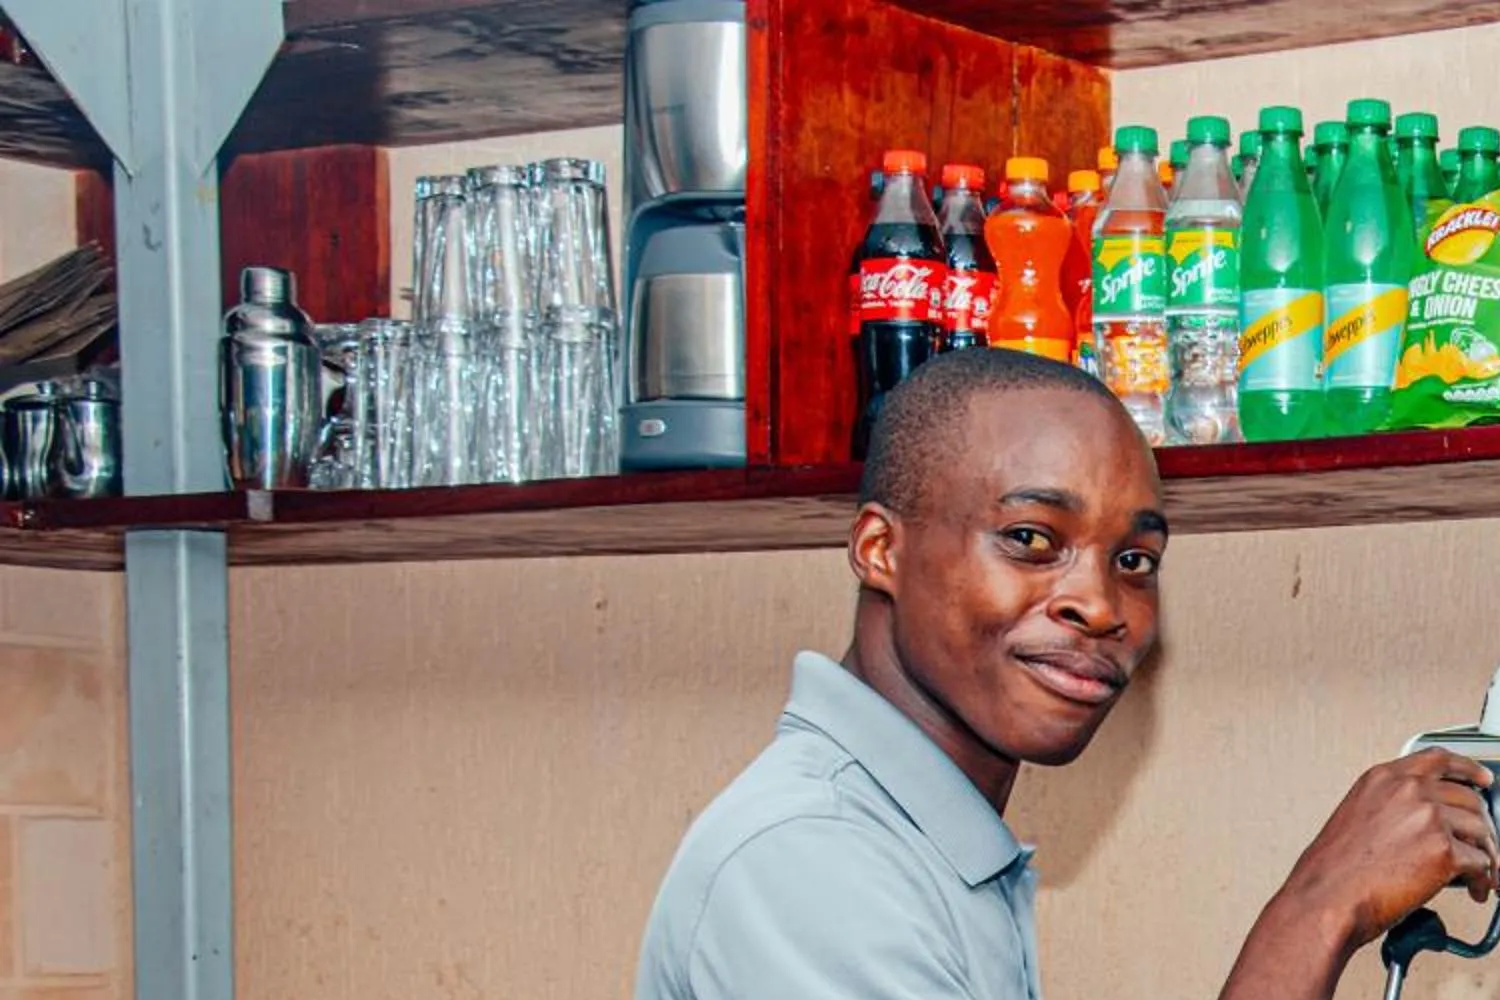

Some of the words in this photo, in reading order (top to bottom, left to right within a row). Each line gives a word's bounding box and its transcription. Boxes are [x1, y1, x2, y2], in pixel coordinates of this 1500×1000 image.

[1100, 256, 1156, 305] Sprite
[1171, 249, 1227, 298] Sprite
[1424, 294, 1478, 319] ONION
